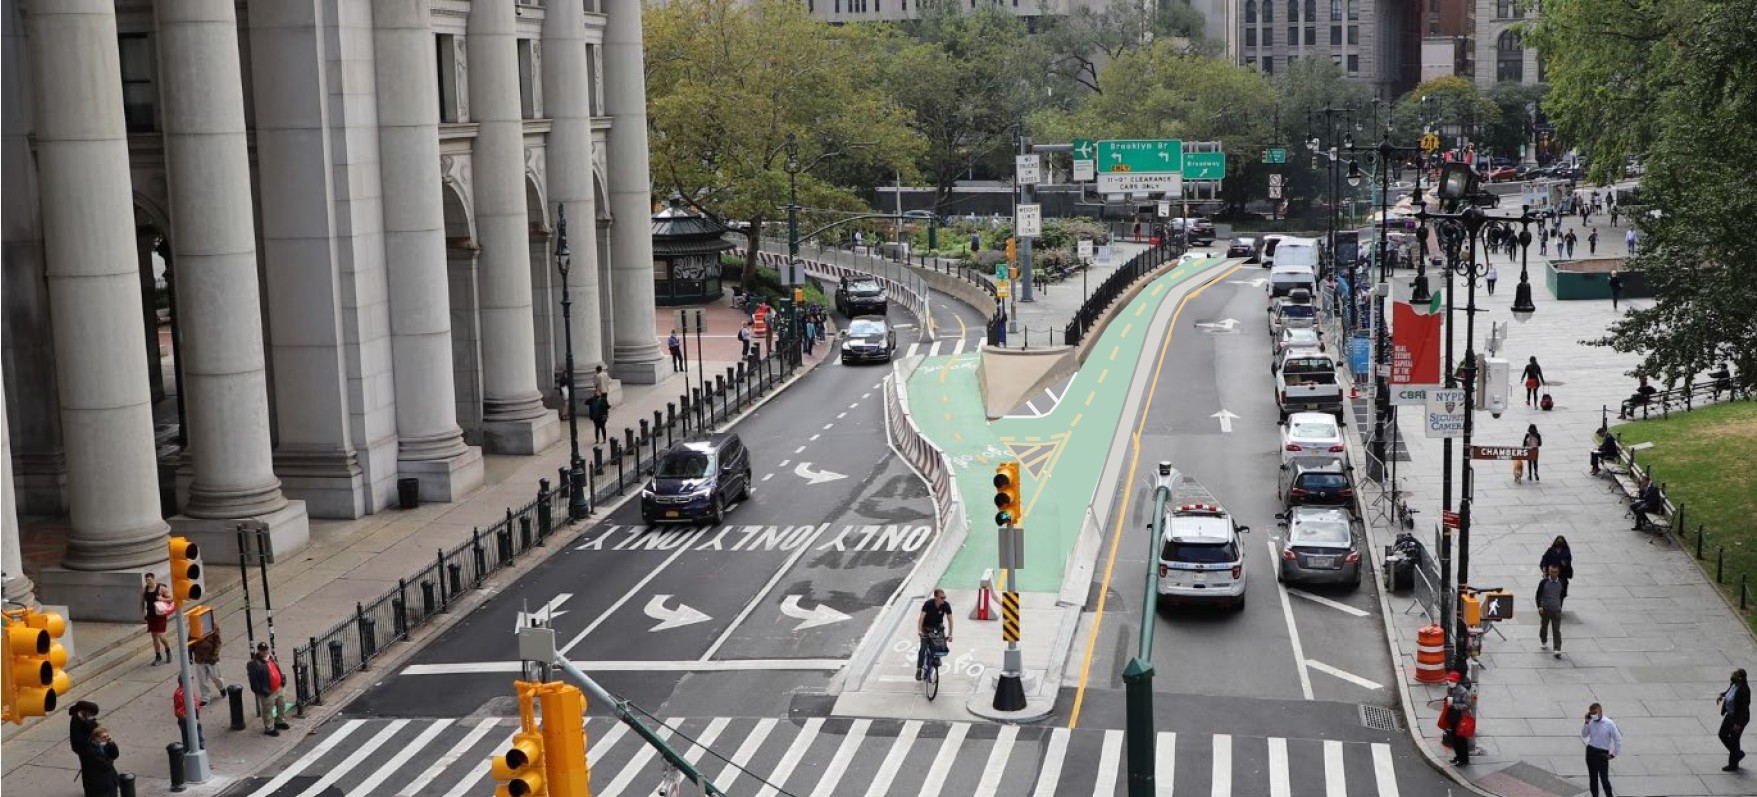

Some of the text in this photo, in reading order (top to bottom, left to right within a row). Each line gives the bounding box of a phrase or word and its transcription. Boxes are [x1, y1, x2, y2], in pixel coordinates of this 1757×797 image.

[1110, 142, 1168, 150] Brooklyn Br
[1430, 412, 1465, 422] SECURIT
[1481, 447, 1528, 457] CHAMBERS
[694, 525, 815, 551] ONLY
[815, 525, 932, 551] ONLY
